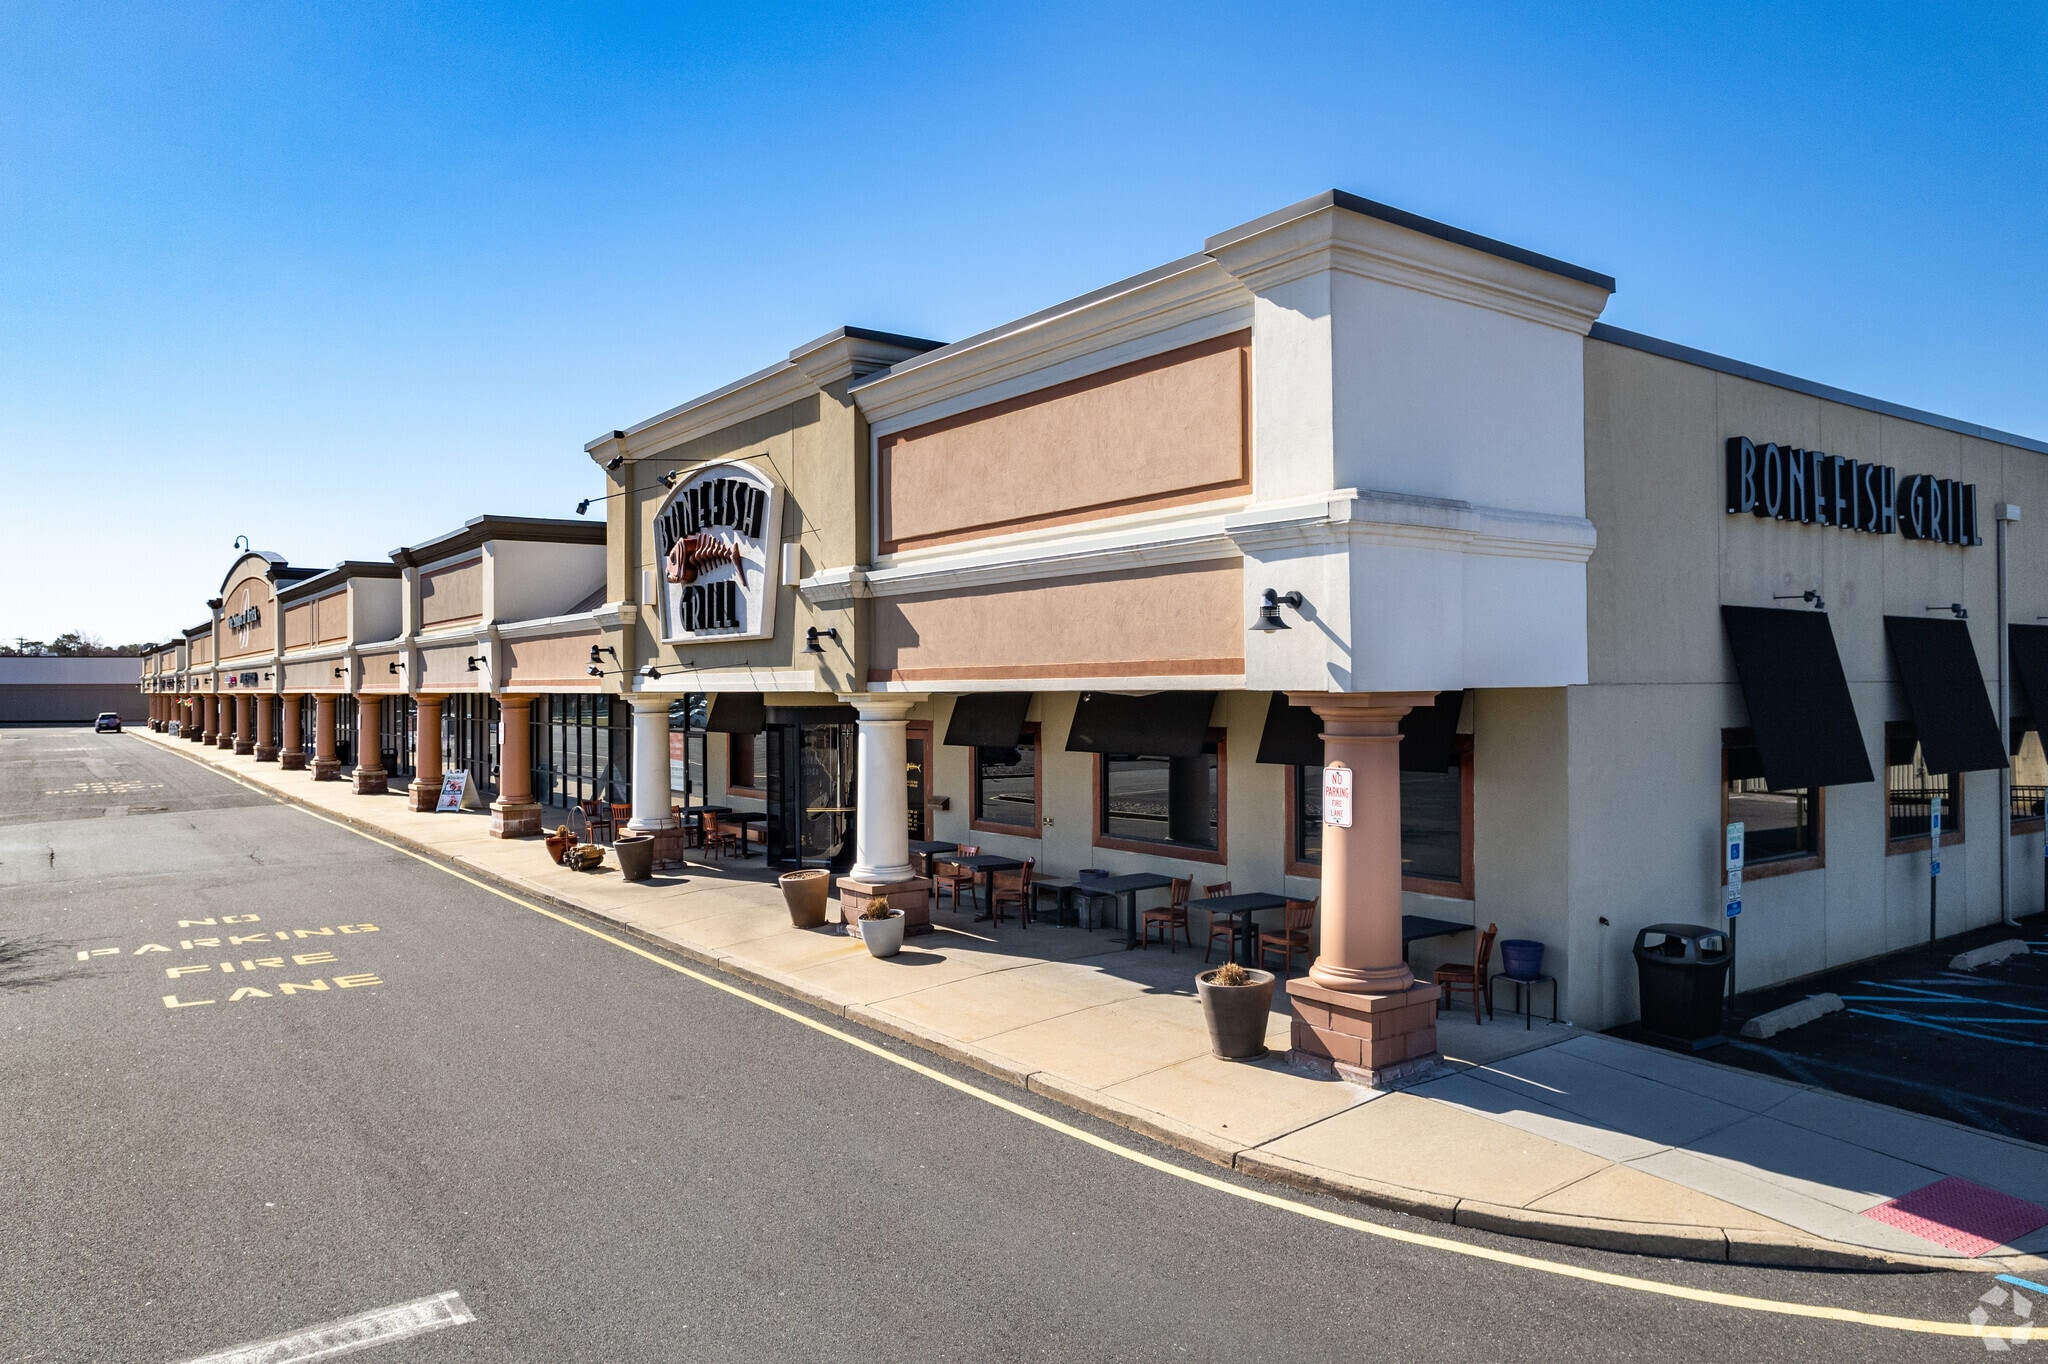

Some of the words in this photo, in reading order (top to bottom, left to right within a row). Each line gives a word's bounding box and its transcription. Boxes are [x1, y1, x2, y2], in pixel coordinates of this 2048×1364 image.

[1726, 436, 1896, 534] BONEFISH
[1897, 474, 1983, 546] GRILL
[658, 478, 765, 556] BONEFISH
[679, 580, 740, 632] GRILL
[1325, 786, 1349, 798] PARKING
[1331, 774, 1343, 784] NO
[1330, 809, 1344, 817] LANE
[1331, 799, 1342, 807] FIRE
[178, 914, 261, 928] NO
[76, 923, 380, 961] PARKING
[165, 952, 339, 979] FIRE
[162, 973, 384, 1009] LANE
